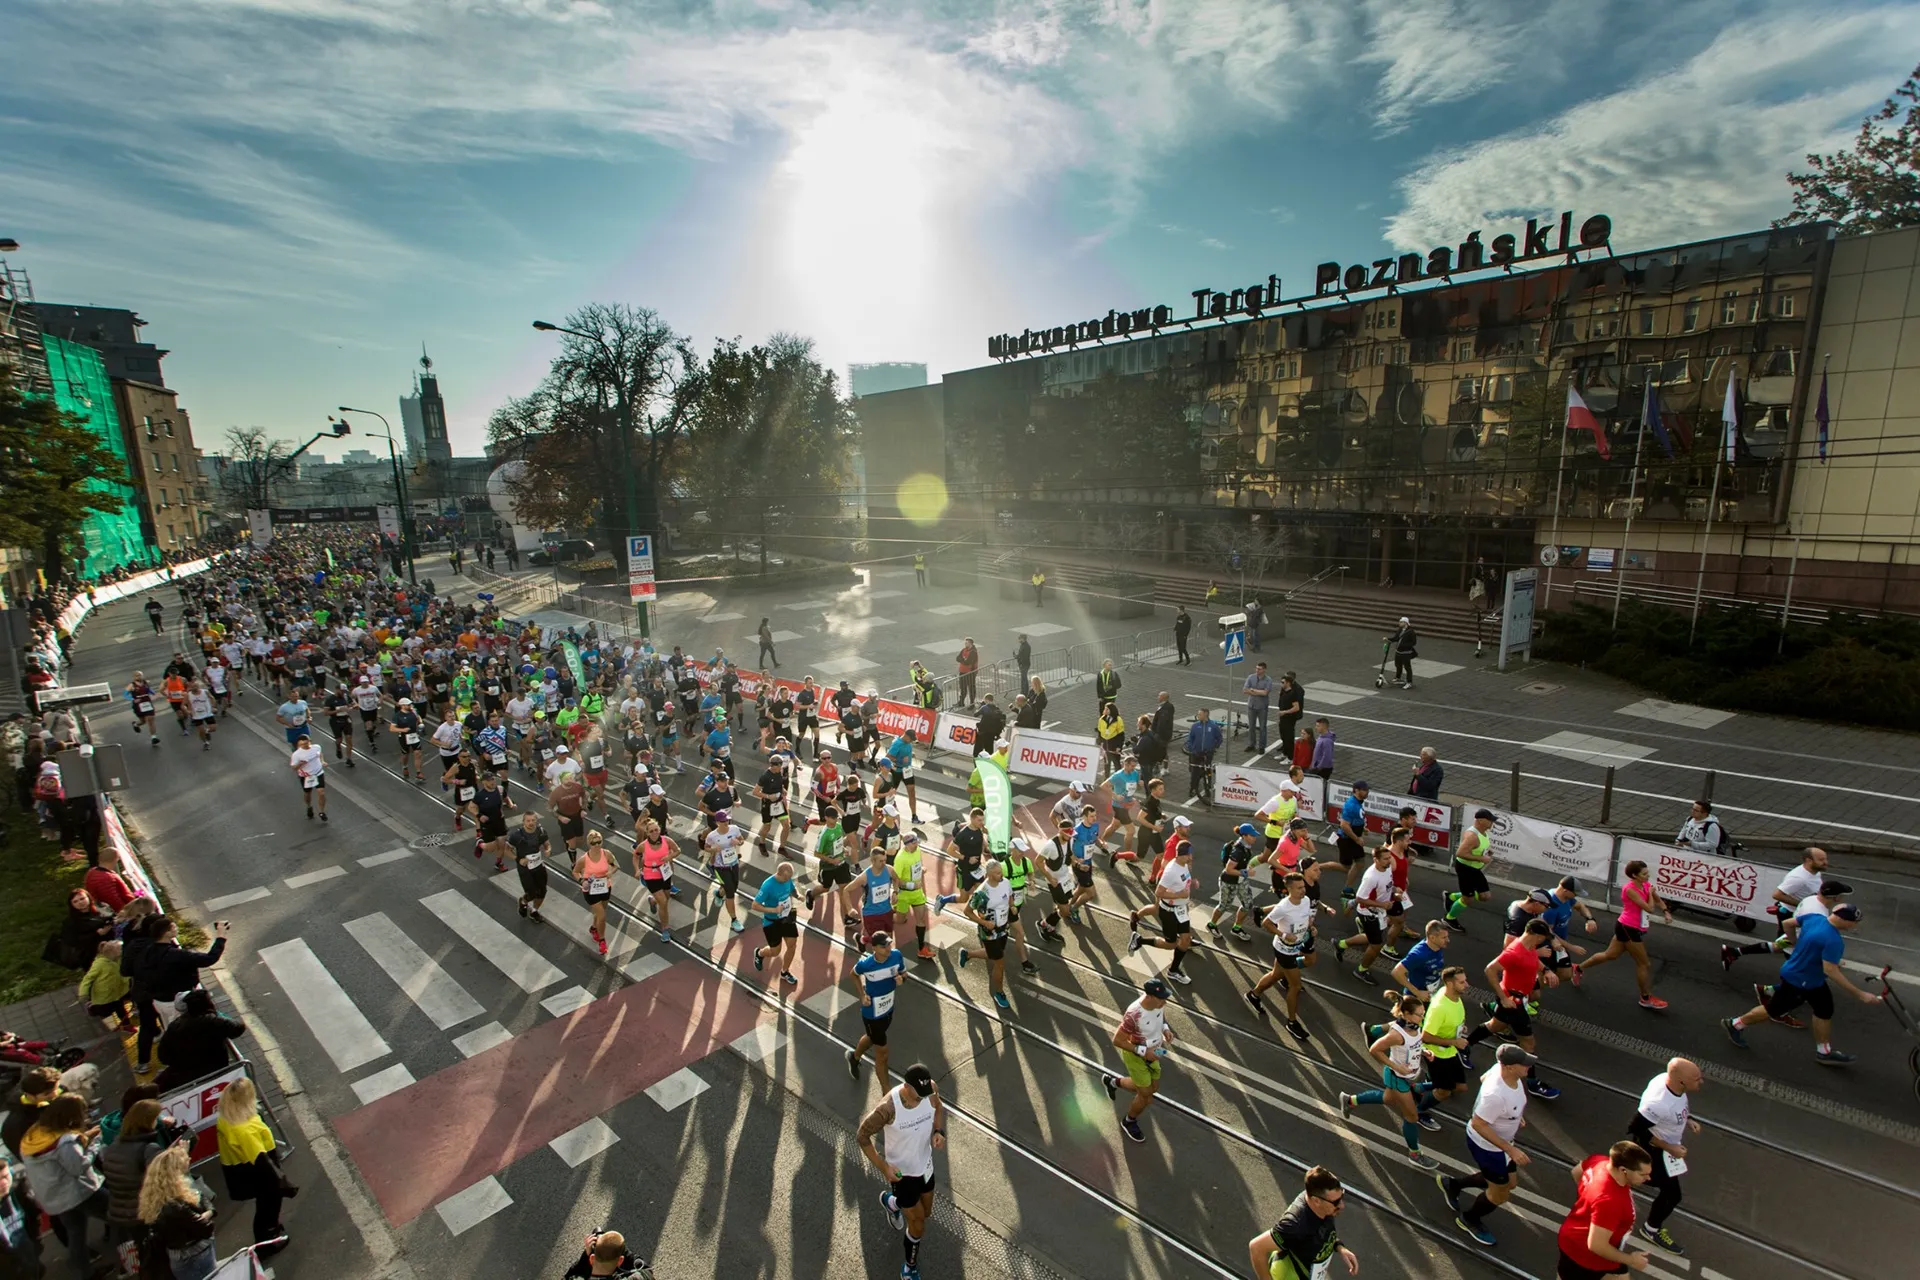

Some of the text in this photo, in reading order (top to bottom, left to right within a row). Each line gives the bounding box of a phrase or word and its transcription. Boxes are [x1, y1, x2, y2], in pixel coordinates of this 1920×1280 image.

[1192, 274, 1282, 317] Targi
[1316, 211, 1612, 293] Poznańskie
[876, 705, 930, 735] terravita
[1020, 747, 1088, 770] RUNNER'S
[1221, 792, 1259, 803] POLSKIE.PL
[1222, 786, 1259, 797] MARATONY
[1660, 854, 1739, 881] DRUŻYNA
[1657, 867, 1757, 901] SZPIKU
[1657, 885, 1747, 913] www.darszpiku.pl
